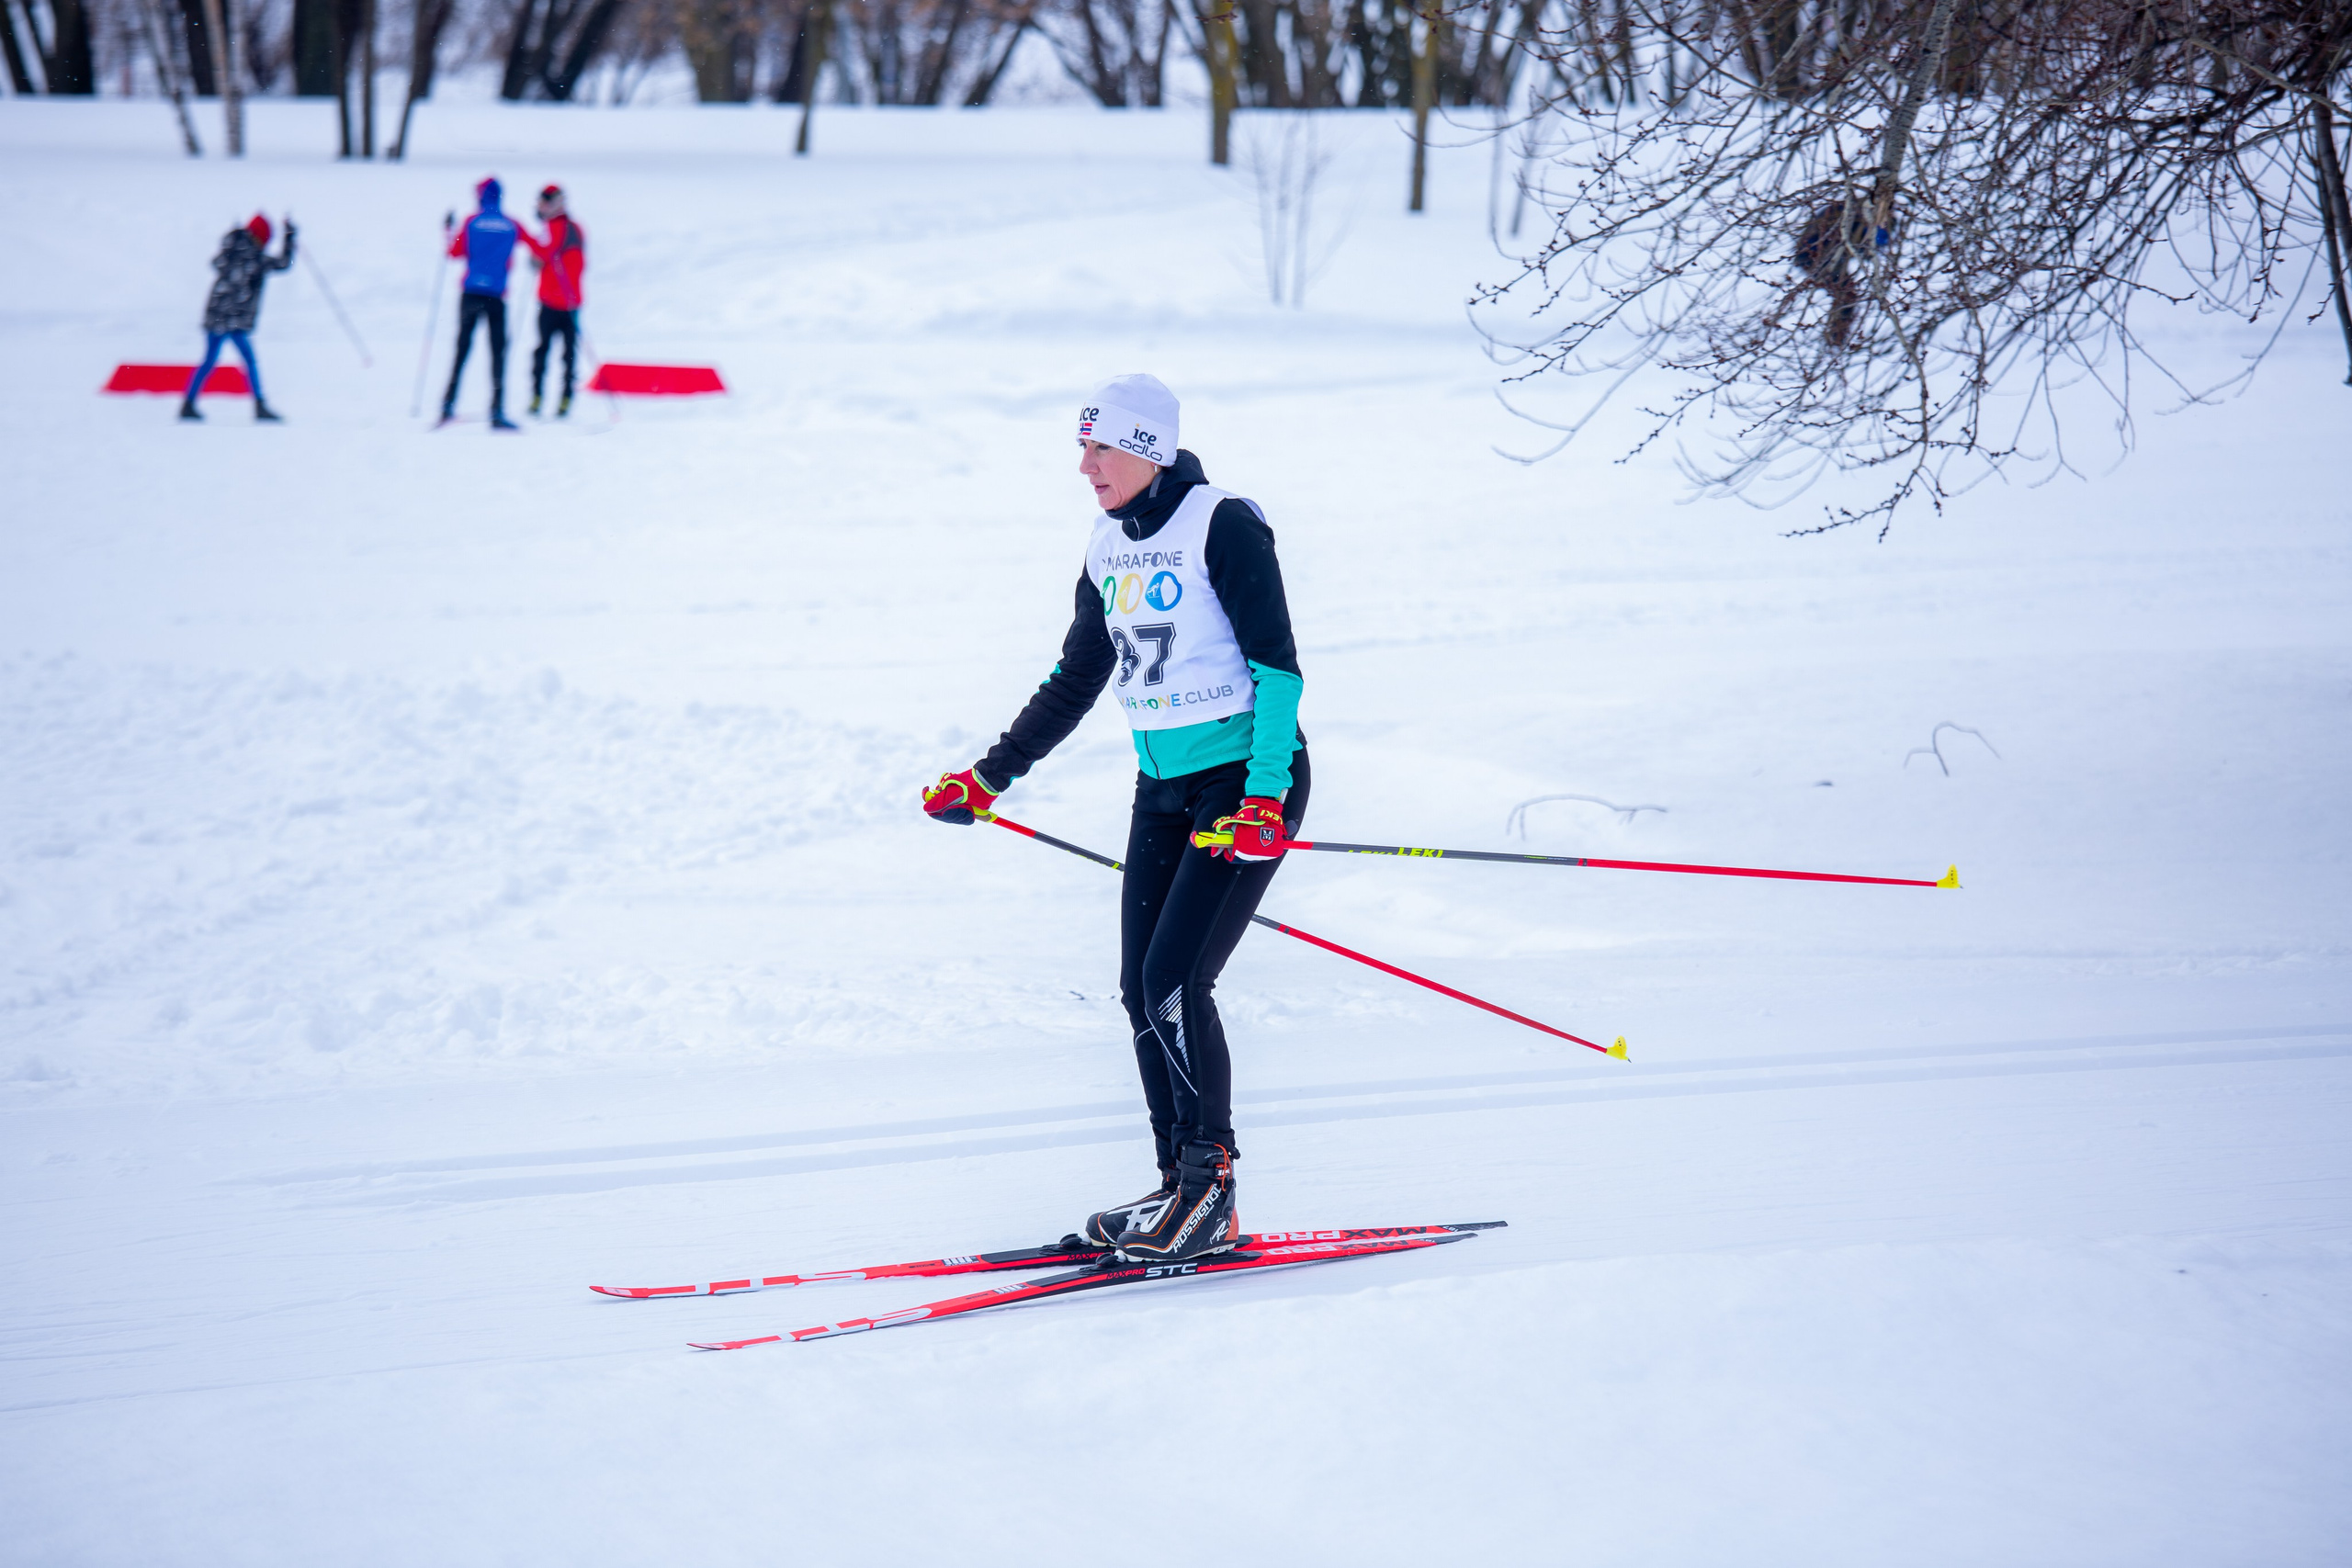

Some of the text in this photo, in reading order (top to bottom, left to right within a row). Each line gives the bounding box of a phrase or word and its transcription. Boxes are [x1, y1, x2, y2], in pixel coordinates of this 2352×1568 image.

[1132, 423, 1158, 446] ice
[1118, 438, 1163, 462] odlo
[1396, 846, 1443, 859] LEKI
[1172, 1183, 1223, 1254] ROSSIGNOL
[1145, 1262, 1198, 1278] STC
